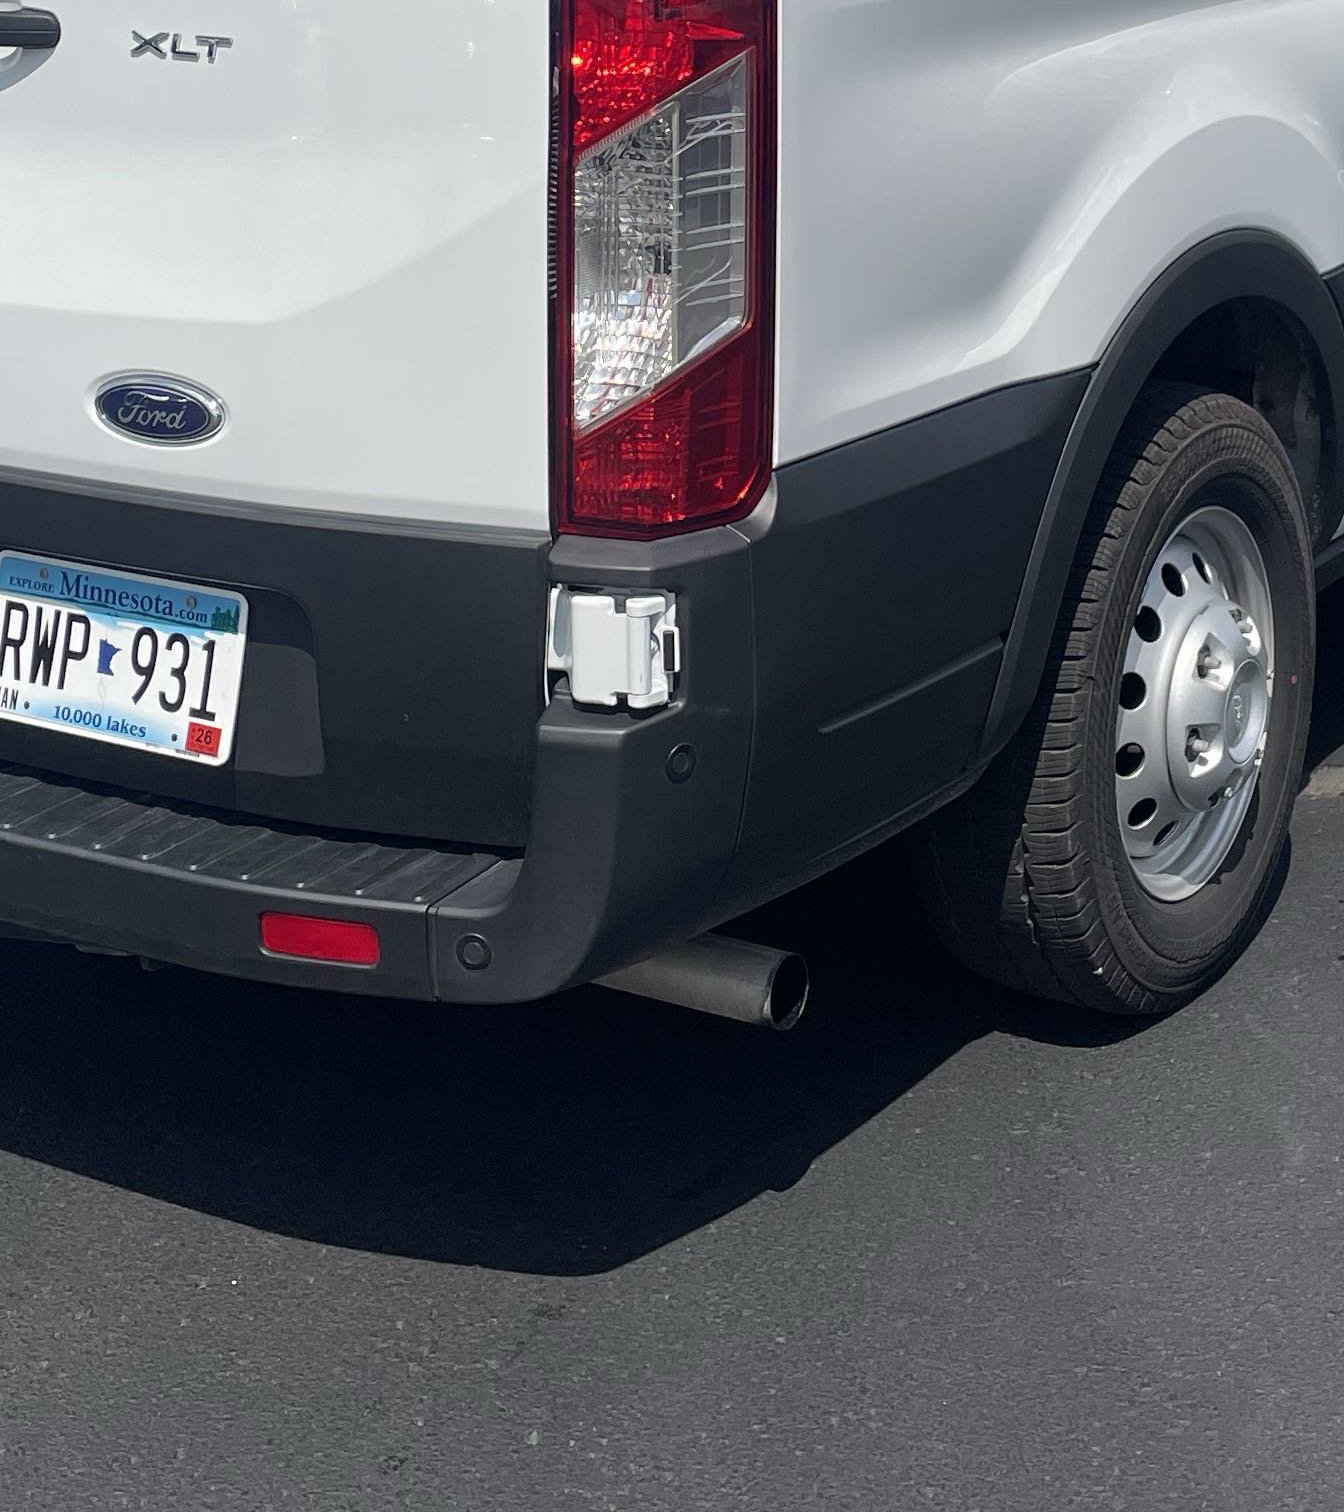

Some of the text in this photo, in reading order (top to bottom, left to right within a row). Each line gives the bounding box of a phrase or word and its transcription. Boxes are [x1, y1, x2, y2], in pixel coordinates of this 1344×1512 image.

[131, 29, 233, 64] XLT
[117, 390, 188, 429] Ford
[9, 575, 55, 593] EXPLORE
[131, 626, 217, 722] 931
[54, 705, 146, 738] 10,000 lakes
[196, 728, 213, 745] 26
